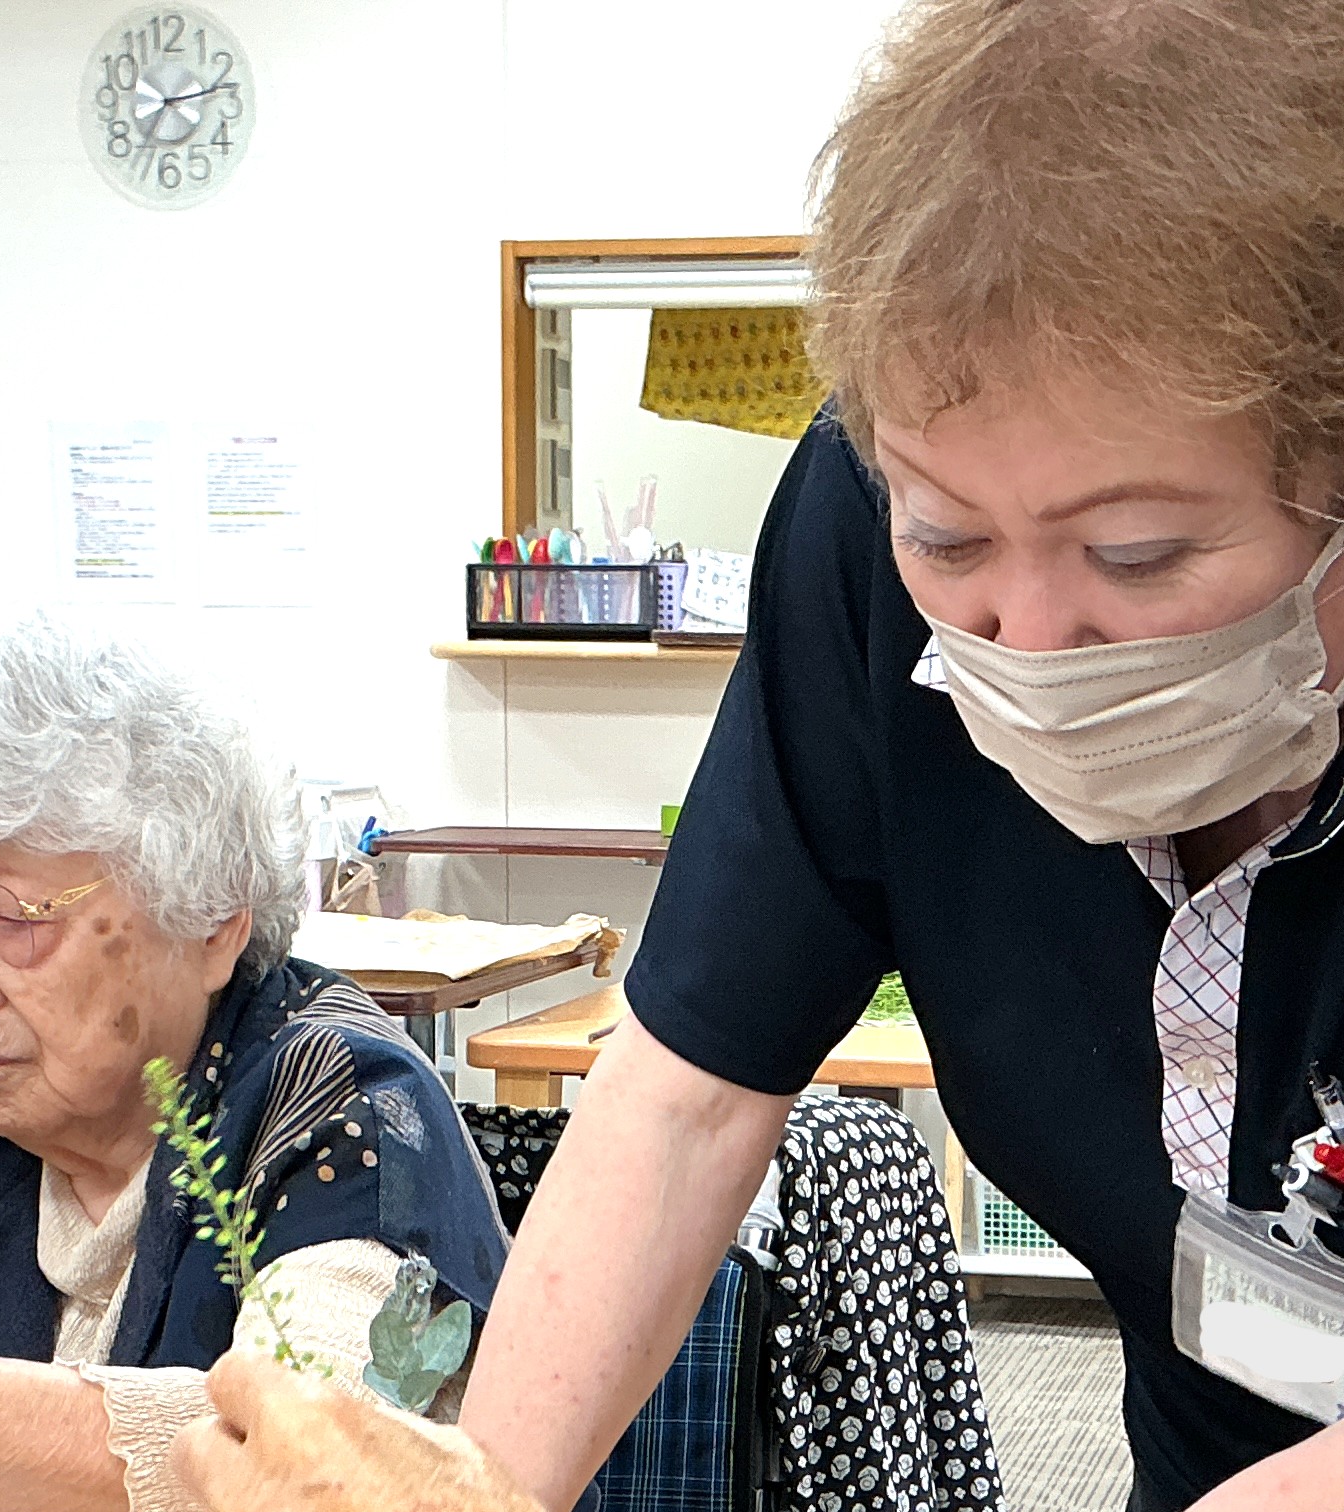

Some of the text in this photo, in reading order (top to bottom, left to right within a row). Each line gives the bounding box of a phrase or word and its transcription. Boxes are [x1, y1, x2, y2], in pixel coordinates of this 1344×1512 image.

[121, 30, 149, 66] 11
[149, 14, 185, 53] 12
[194, 29, 207, 65] 1
[100, 53, 139, 91] 10
[211, 51, 239, 89] 2
[96, 84, 119, 122] 9
[218, 86, 244, 120] 3
[107, 119, 133, 158] 8
[209, 119, 234, 156] 4
[133, 144, 158, 182] 7
[157, 152, 182, 189] 6
[187, 143, 212, 181] 5
